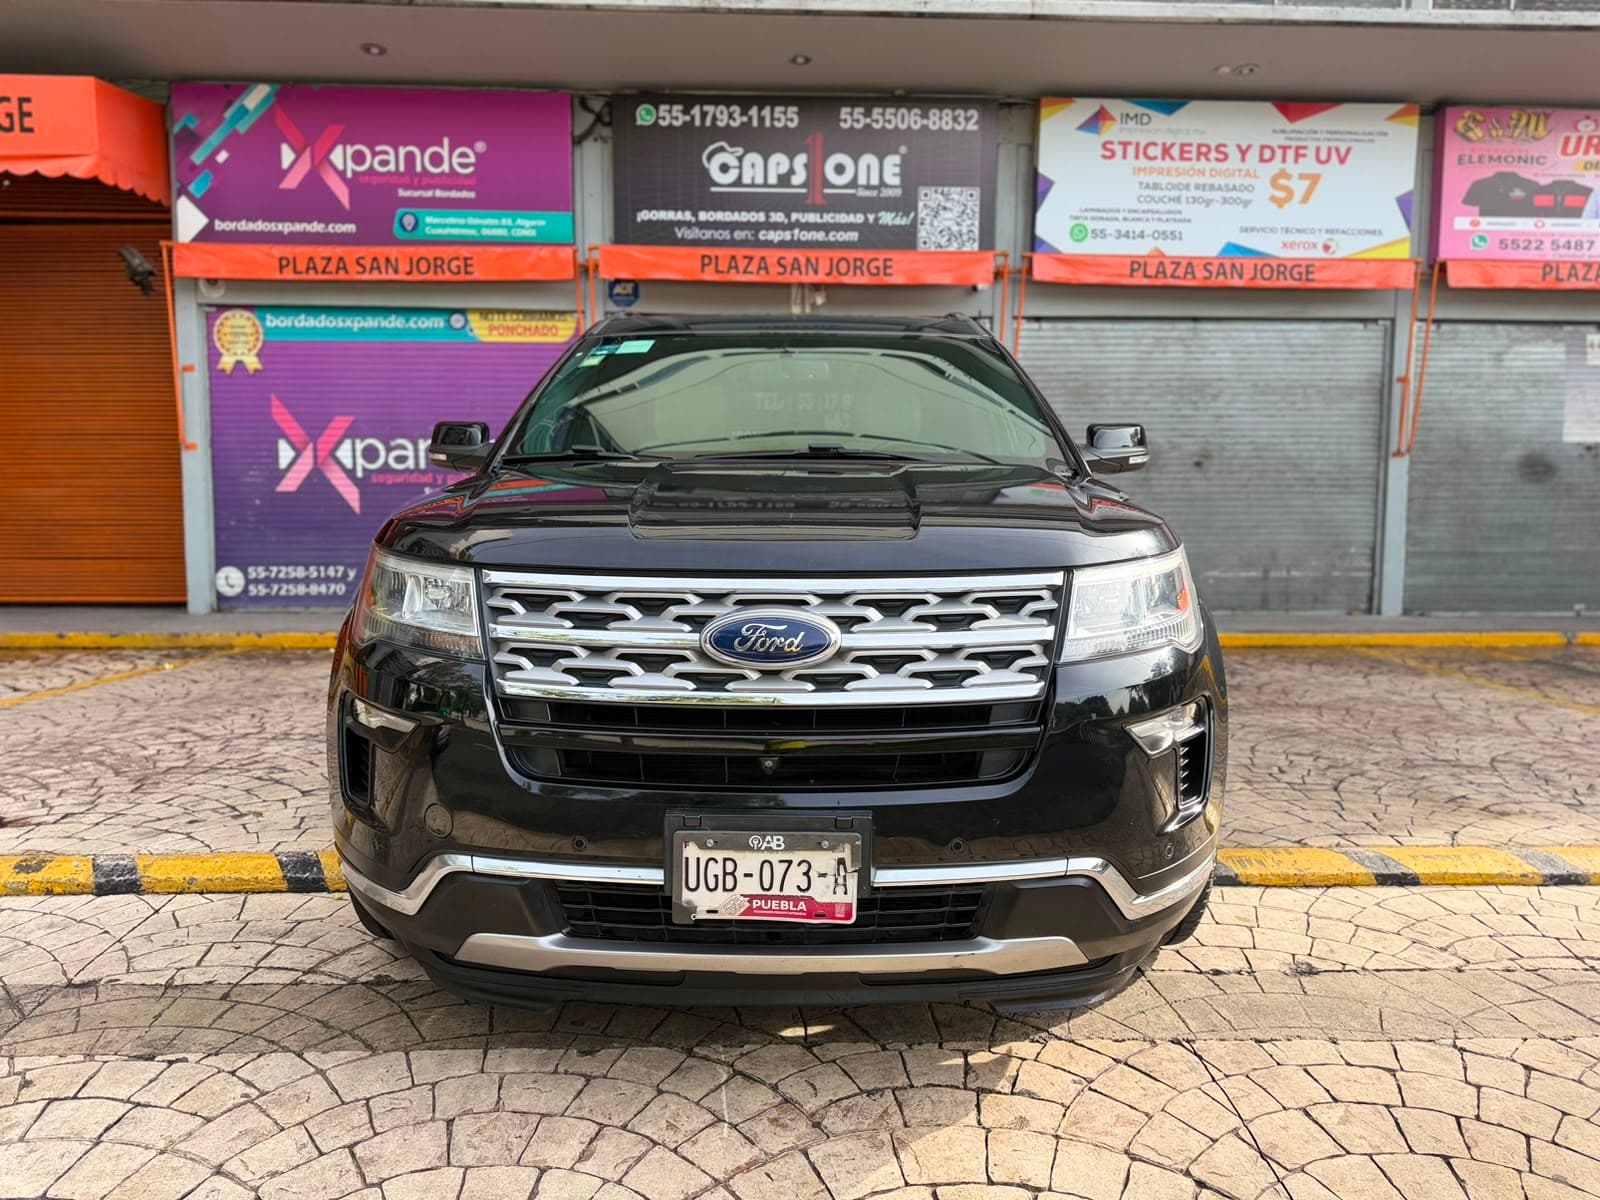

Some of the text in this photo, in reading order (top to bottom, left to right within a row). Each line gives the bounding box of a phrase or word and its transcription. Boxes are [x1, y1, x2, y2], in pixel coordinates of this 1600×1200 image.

[658, 104, 799, 128] 55-1793-1155
[839, 106, 979, 131] 55-5506-8832
[1119, 112, 1152, 126] IMD
[1101, 140, 1353, 165] STICKERS Y DTF UV
[1132, 165, 1261, 179] IMPRESIÓN DIGITAL
[1138, 181, 1256, 193] TABLOIDE REBASADO
[1268, 168, 1322, 208] $7
[1137, 193, 1182, 205] COUCHÉ
[698, 210, 767, 223] BORDADOS
[790, 212, 865, 224] PUBLICIDAD
[867, 213, 876, 225] Y
[214, 219, 357, 235] bordadosxpande.com
[1090, 228, 1183, 241] 55-3414-0551
[1281, 240, 1318, 250] xerox
[1499, 238, 1595, 252] 5522 5487
[278, 256, 475, 276] PLAZA SAN JORGE
[700, 254, 894, 277] PLAZA SAN JORGE
[1129, 260, 1315, 282] PLAZA SAN JORGE
[265, 313, 445, 332] bordadosxpande.com
[347, 567, 357, 581] y
[734, 623, 806, 654] Ford
[684, 856, 849, 896] UGB-073-A
[752, 899, 807, 912] PUEBLA
